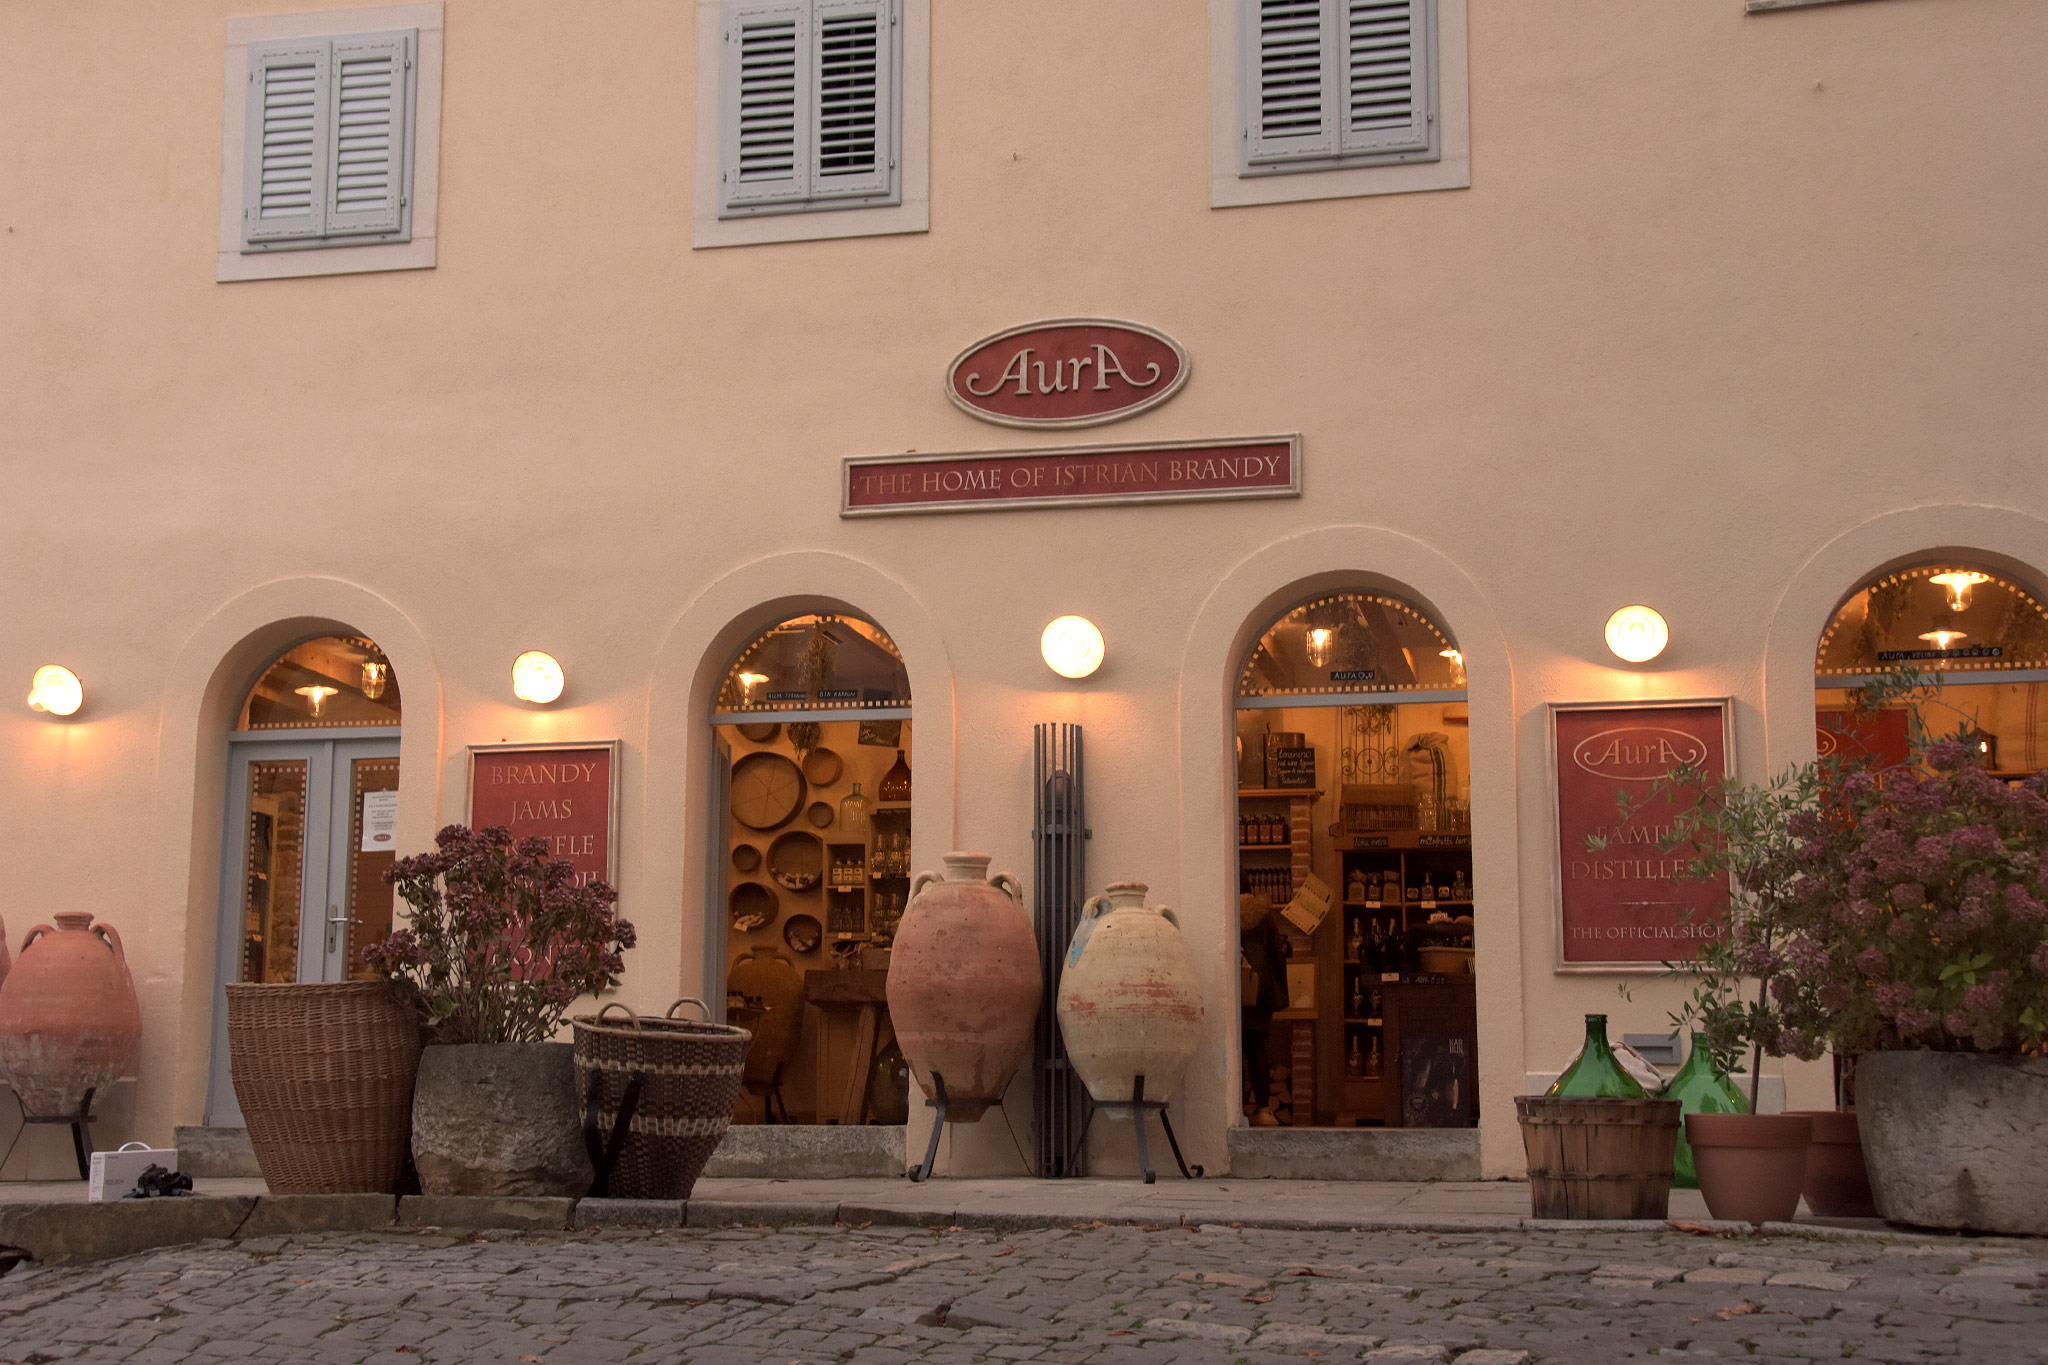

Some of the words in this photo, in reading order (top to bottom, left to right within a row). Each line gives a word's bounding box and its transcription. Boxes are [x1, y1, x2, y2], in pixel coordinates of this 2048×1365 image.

[860, 472, 912, 496] THE
[920, 469, 1002, 492] HOME
[1010, 465, 1045, 488] OF
[1054, 460, 1160, 487] ISTRIAN
[1169, 455, 1281, 480] BRANDY
[491, 763, 596, 786] BRANDY
[511, 799, 573, 826] JAMS
[1569, 926, 1601, 939] THE
[1606, 926, 1678, 940] OFFICIAL
